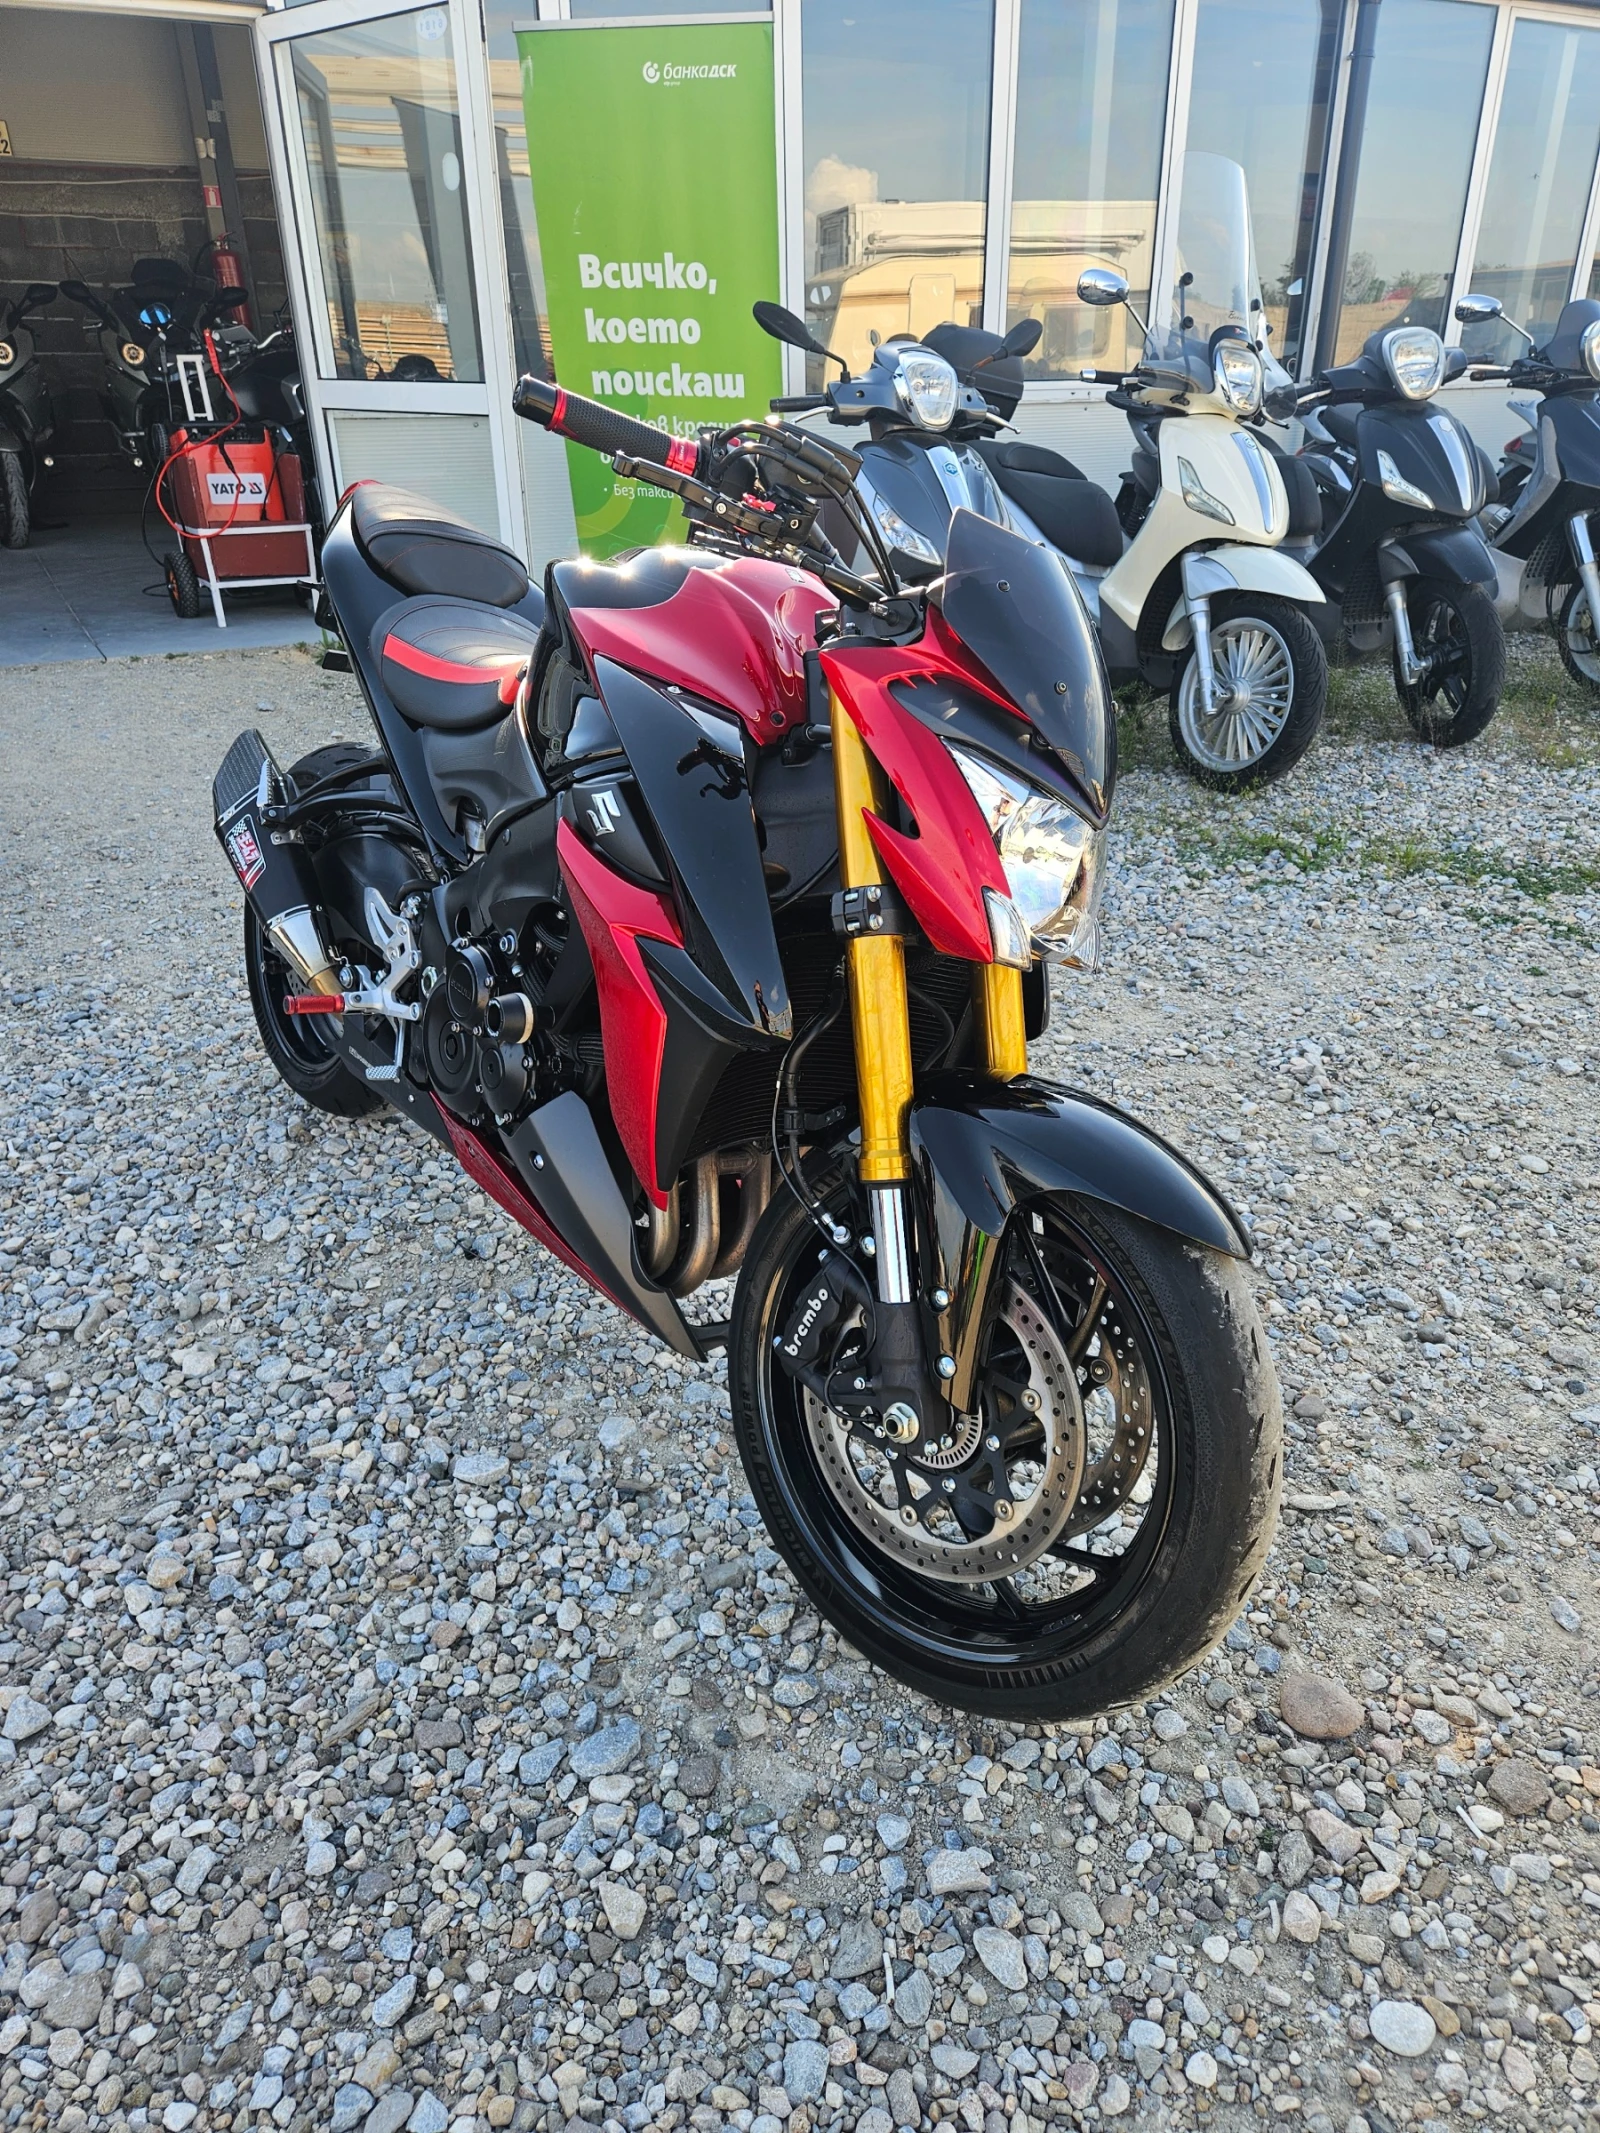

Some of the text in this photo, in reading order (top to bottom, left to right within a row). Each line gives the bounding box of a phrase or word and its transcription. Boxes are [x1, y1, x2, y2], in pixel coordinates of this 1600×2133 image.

[0, 139, 11, 154] 2
[578, 252, 717, 295] Всичко,
[584, 308, 701, 345] което
[592, 363, 745, 398] поискаш
[211, 483, 246, 494] YATO
[613, 483, 635, 500] Без
[784, 1288, 829, 1356] brembo
[743, 1390, 812, 1567] MICHELIN POWER
